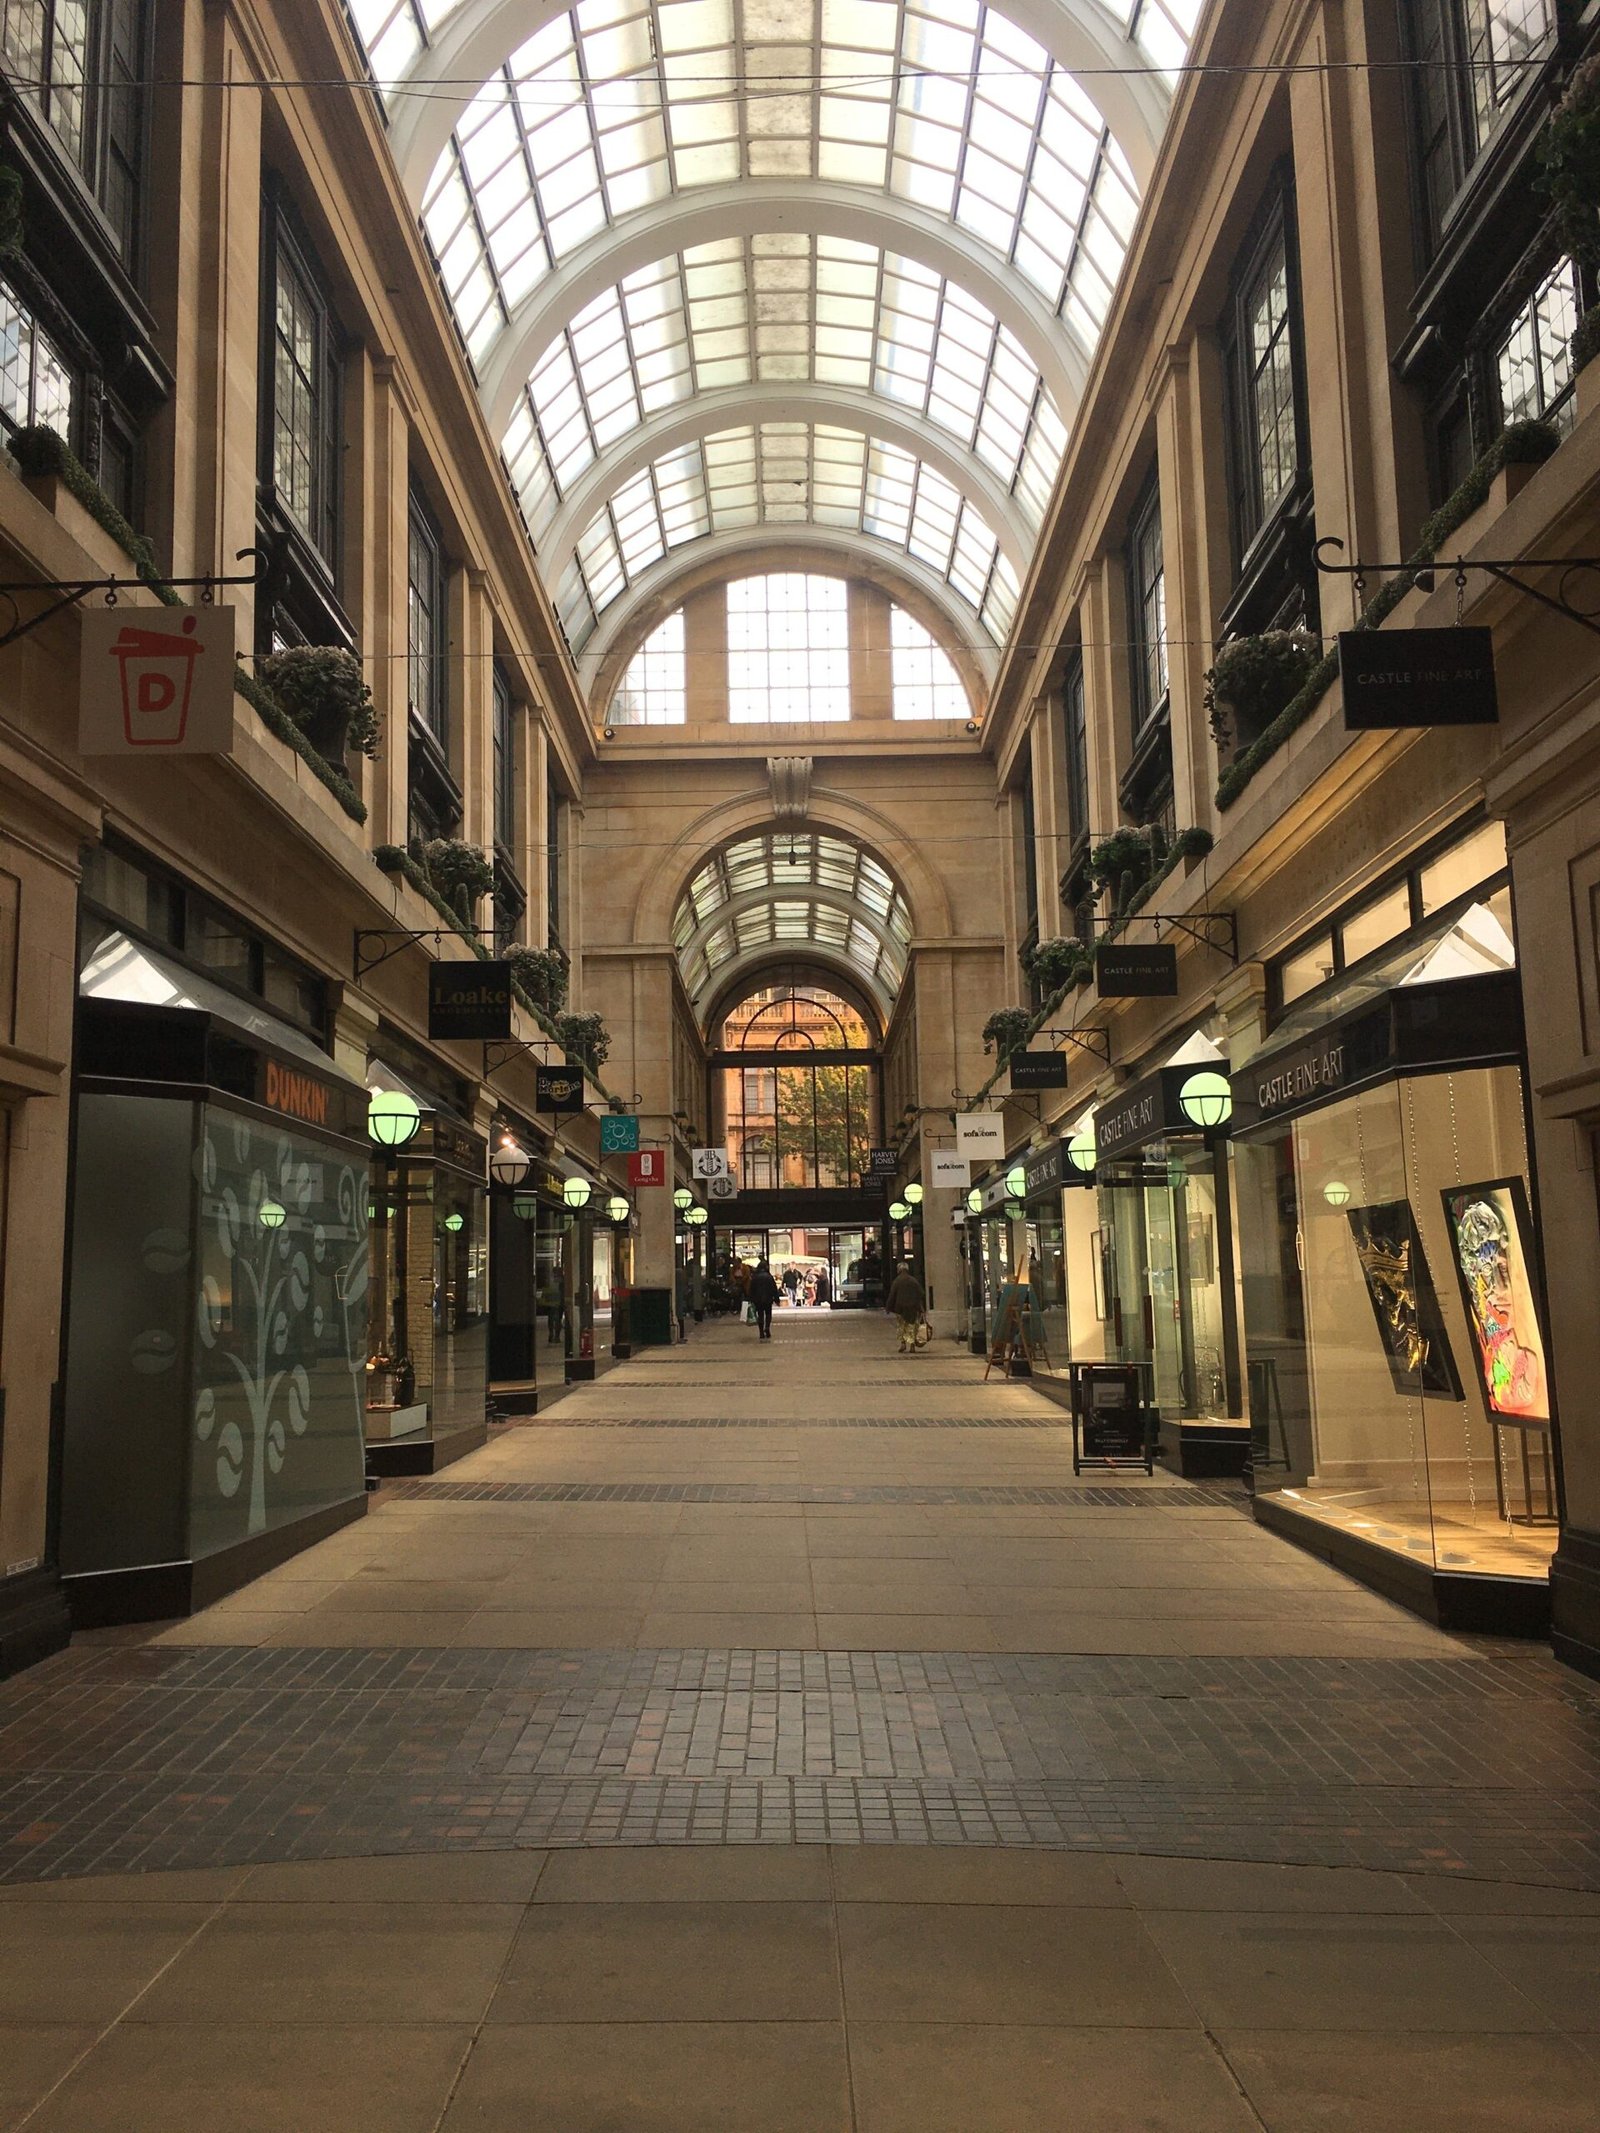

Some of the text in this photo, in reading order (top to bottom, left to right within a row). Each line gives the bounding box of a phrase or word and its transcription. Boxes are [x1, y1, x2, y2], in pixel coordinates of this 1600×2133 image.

[1357, 668, 1482, 685] CASTLE FINE ART
[138, 673, 176, 713] D
[1104, 966, 1169, 975] CASTLE FINE ART
[432, 986, 507, 1005] Loake
[1258, 1045, 1345, 1109] CASTLE FINE ART
[538, 1081, 581, 1095] Martens
[1099, 1095, 1153, 1147] CASTLE FINE ART
[963, 1129, 997, 1138] sofa.com
[874, 1158, 895, 1166] JONES
